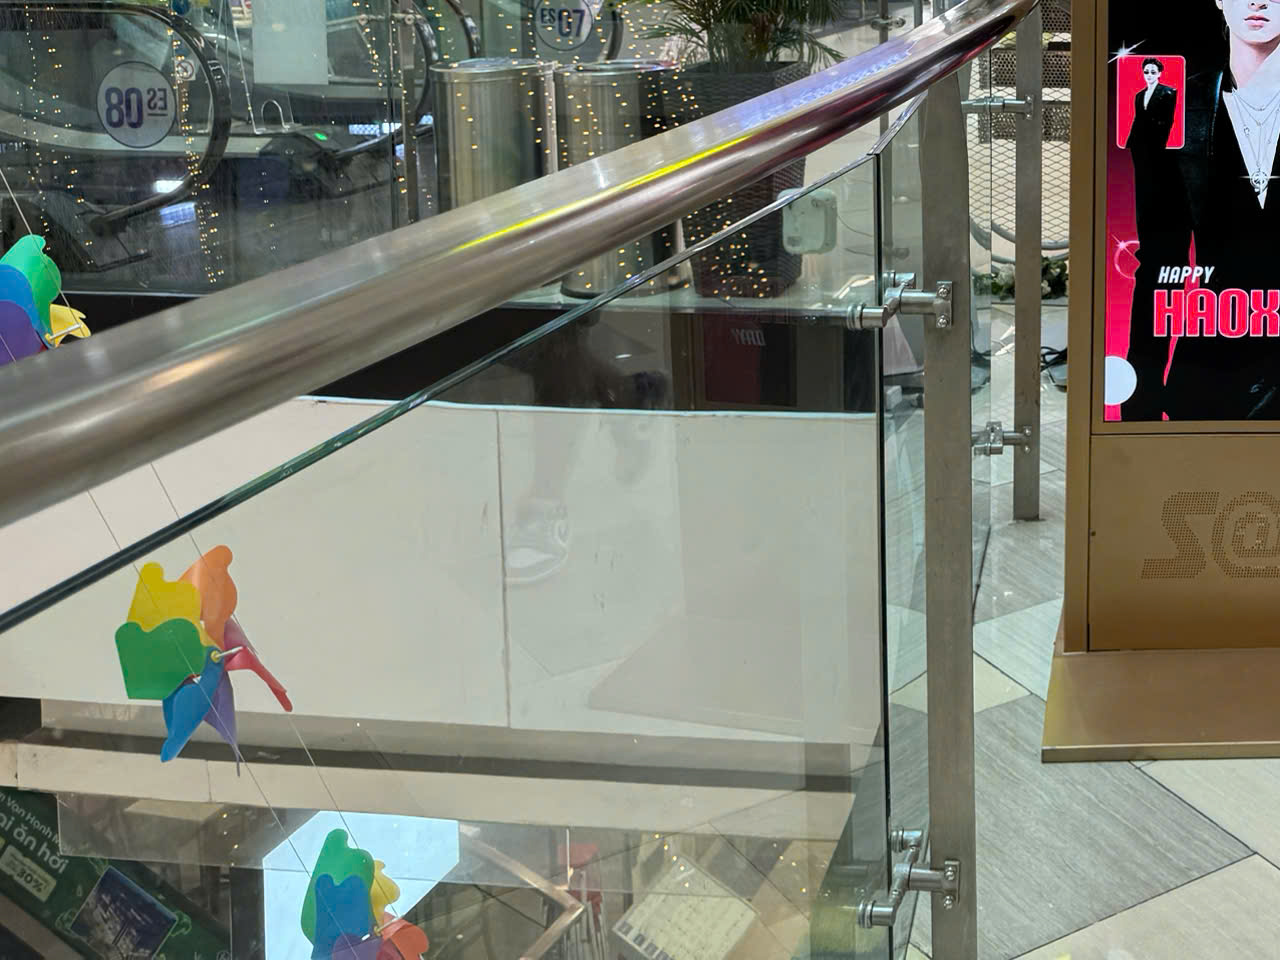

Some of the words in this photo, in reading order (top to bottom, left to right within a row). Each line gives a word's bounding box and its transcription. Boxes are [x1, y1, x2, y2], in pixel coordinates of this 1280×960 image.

[540, 8, 556, 24] ES
[558, 9, 586, 37] 07
[1157, 266, 1215, 283] HAPPY
